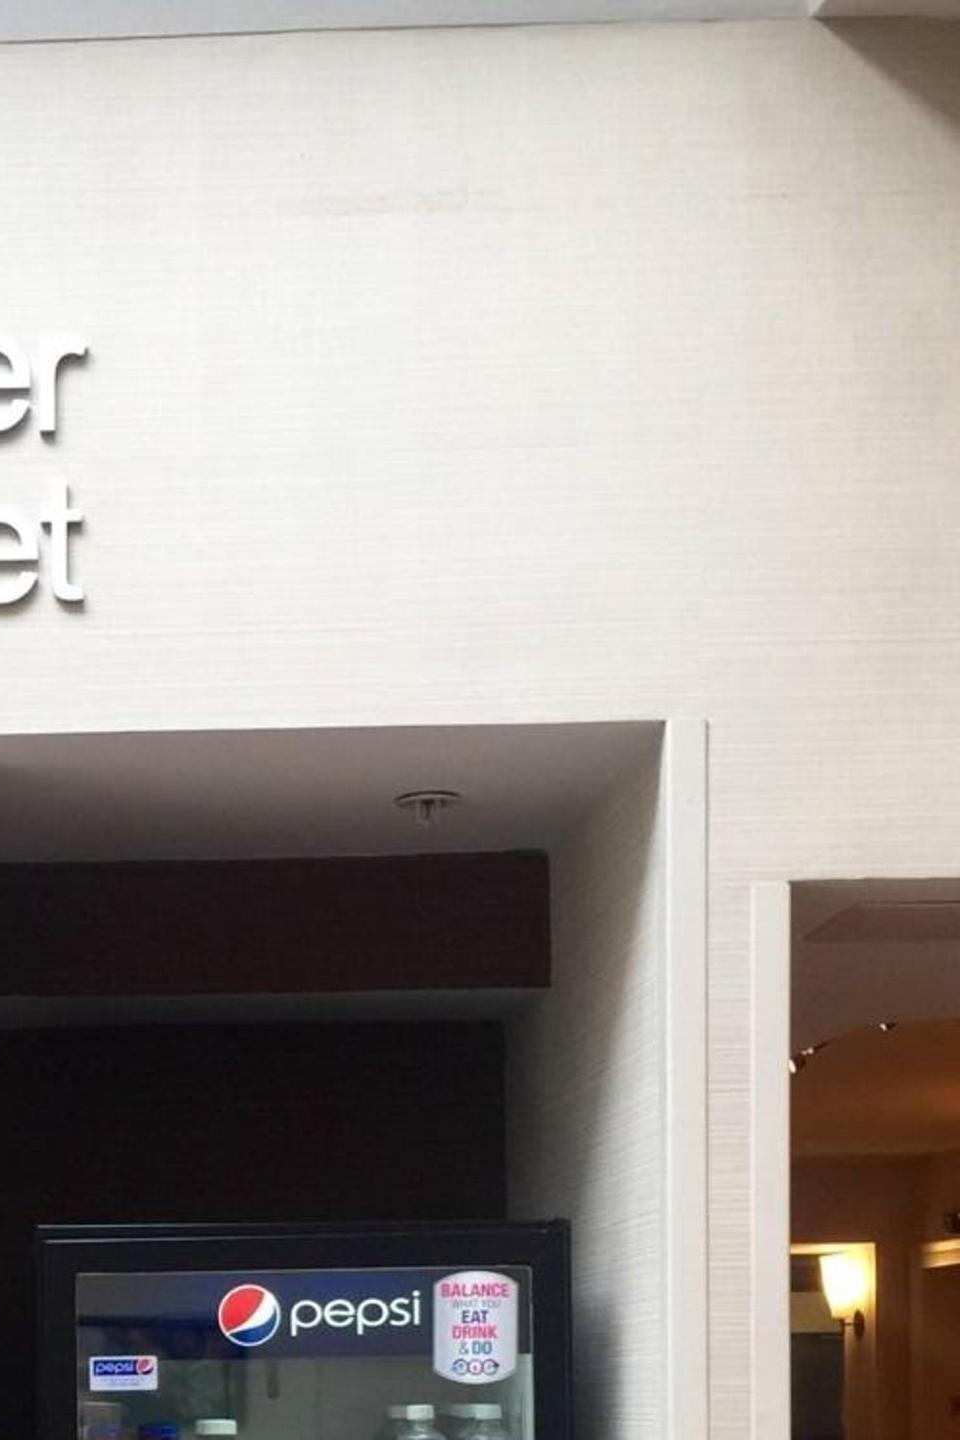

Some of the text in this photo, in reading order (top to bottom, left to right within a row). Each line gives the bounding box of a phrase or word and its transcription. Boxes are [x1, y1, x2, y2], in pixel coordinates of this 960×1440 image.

[440, 1282, 511, 1299] BALANCE
[290, 1289, 422, 1338] pepsi
[461, 1309, 490, 1323] EAT
[451, 1325, 498, 1340] DRINK
[472, 1341, 493, 1355] DO
[95, 1361, 135, 1376] pepsi
